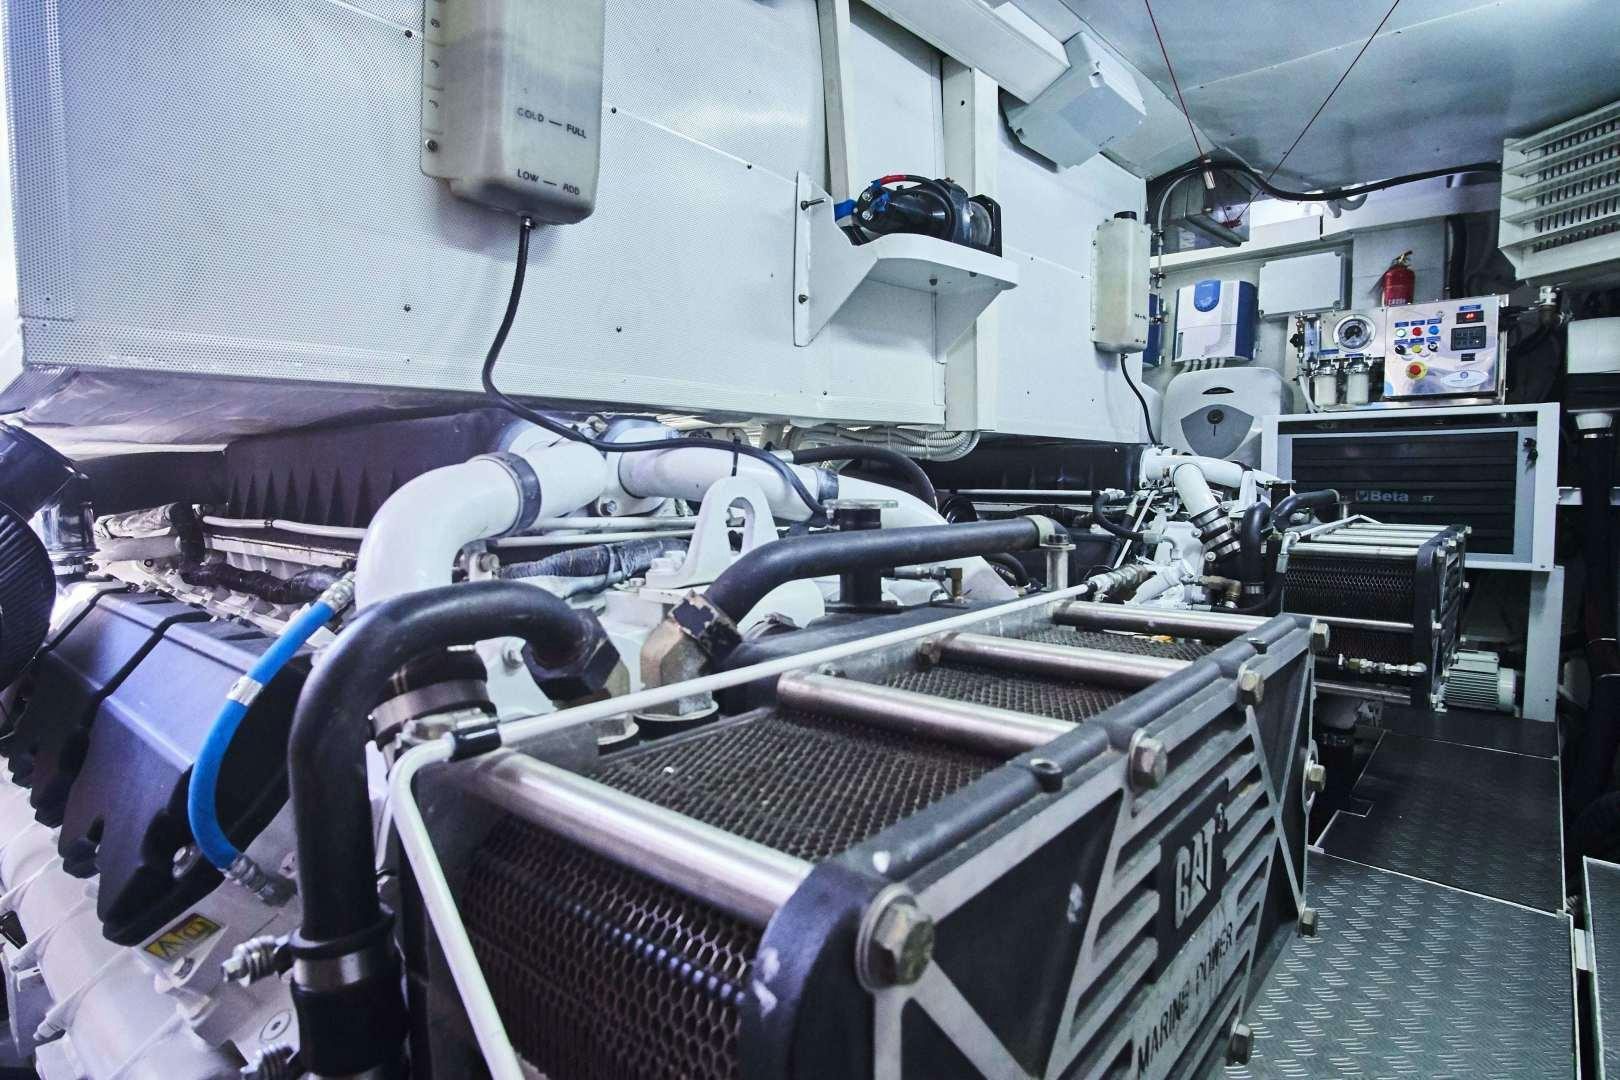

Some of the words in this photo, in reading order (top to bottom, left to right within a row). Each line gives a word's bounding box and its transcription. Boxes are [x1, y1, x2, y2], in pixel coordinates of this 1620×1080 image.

[516, 107, 545, 122] COLD
[566, 123, 587, 139] FULL
[517, 168, 539, 183] LOW
[562, 183, 580, 195] ADD
[1370, 489, 1408, 502] Beta
[1137, 983, 1190, 1080] MARINE
